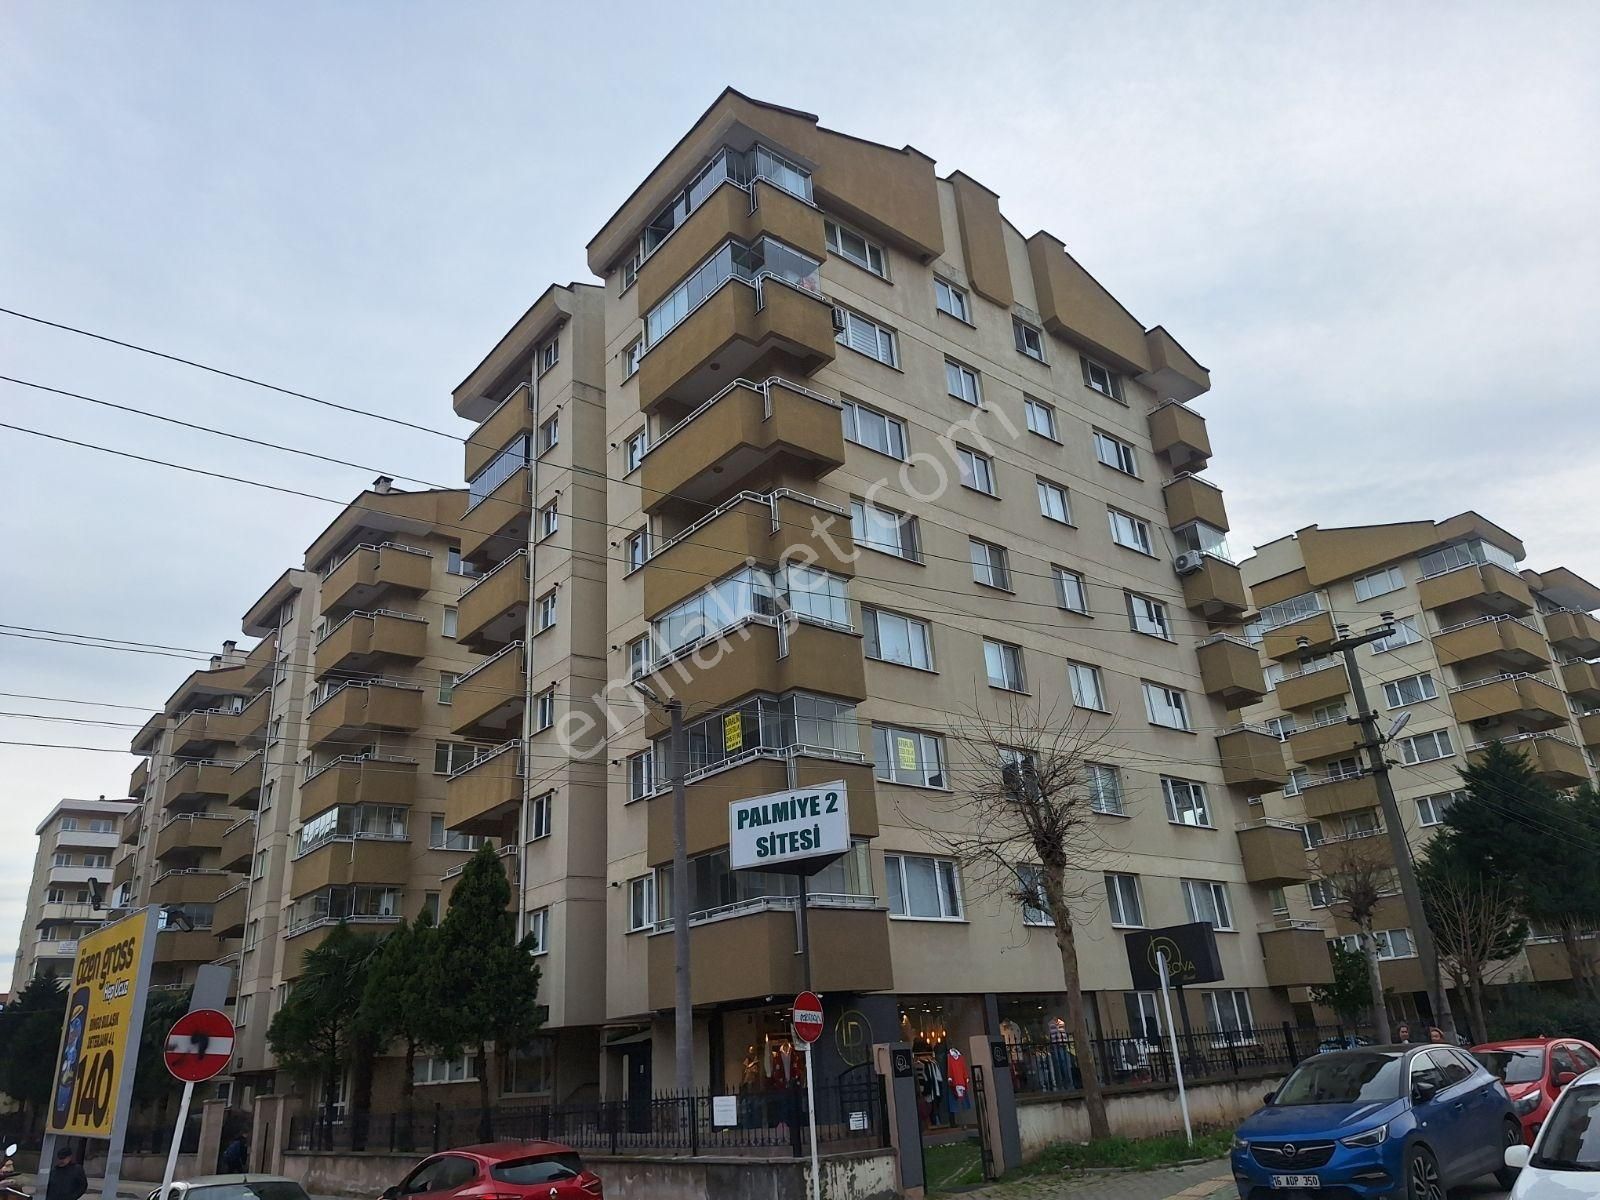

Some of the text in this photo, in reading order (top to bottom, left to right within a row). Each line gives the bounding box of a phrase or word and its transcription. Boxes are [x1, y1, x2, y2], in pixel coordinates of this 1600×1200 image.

[737, 792, 838, 830] PALMİYE 2
[756, 824, 820, 858] SİTESİ
[99, 937, 135, 990] gross
[72, 1049, 114, 1128] 140
[1274, 1176, 1281, 1186] 16
[1303, 1176, 1317, 1186] 350
